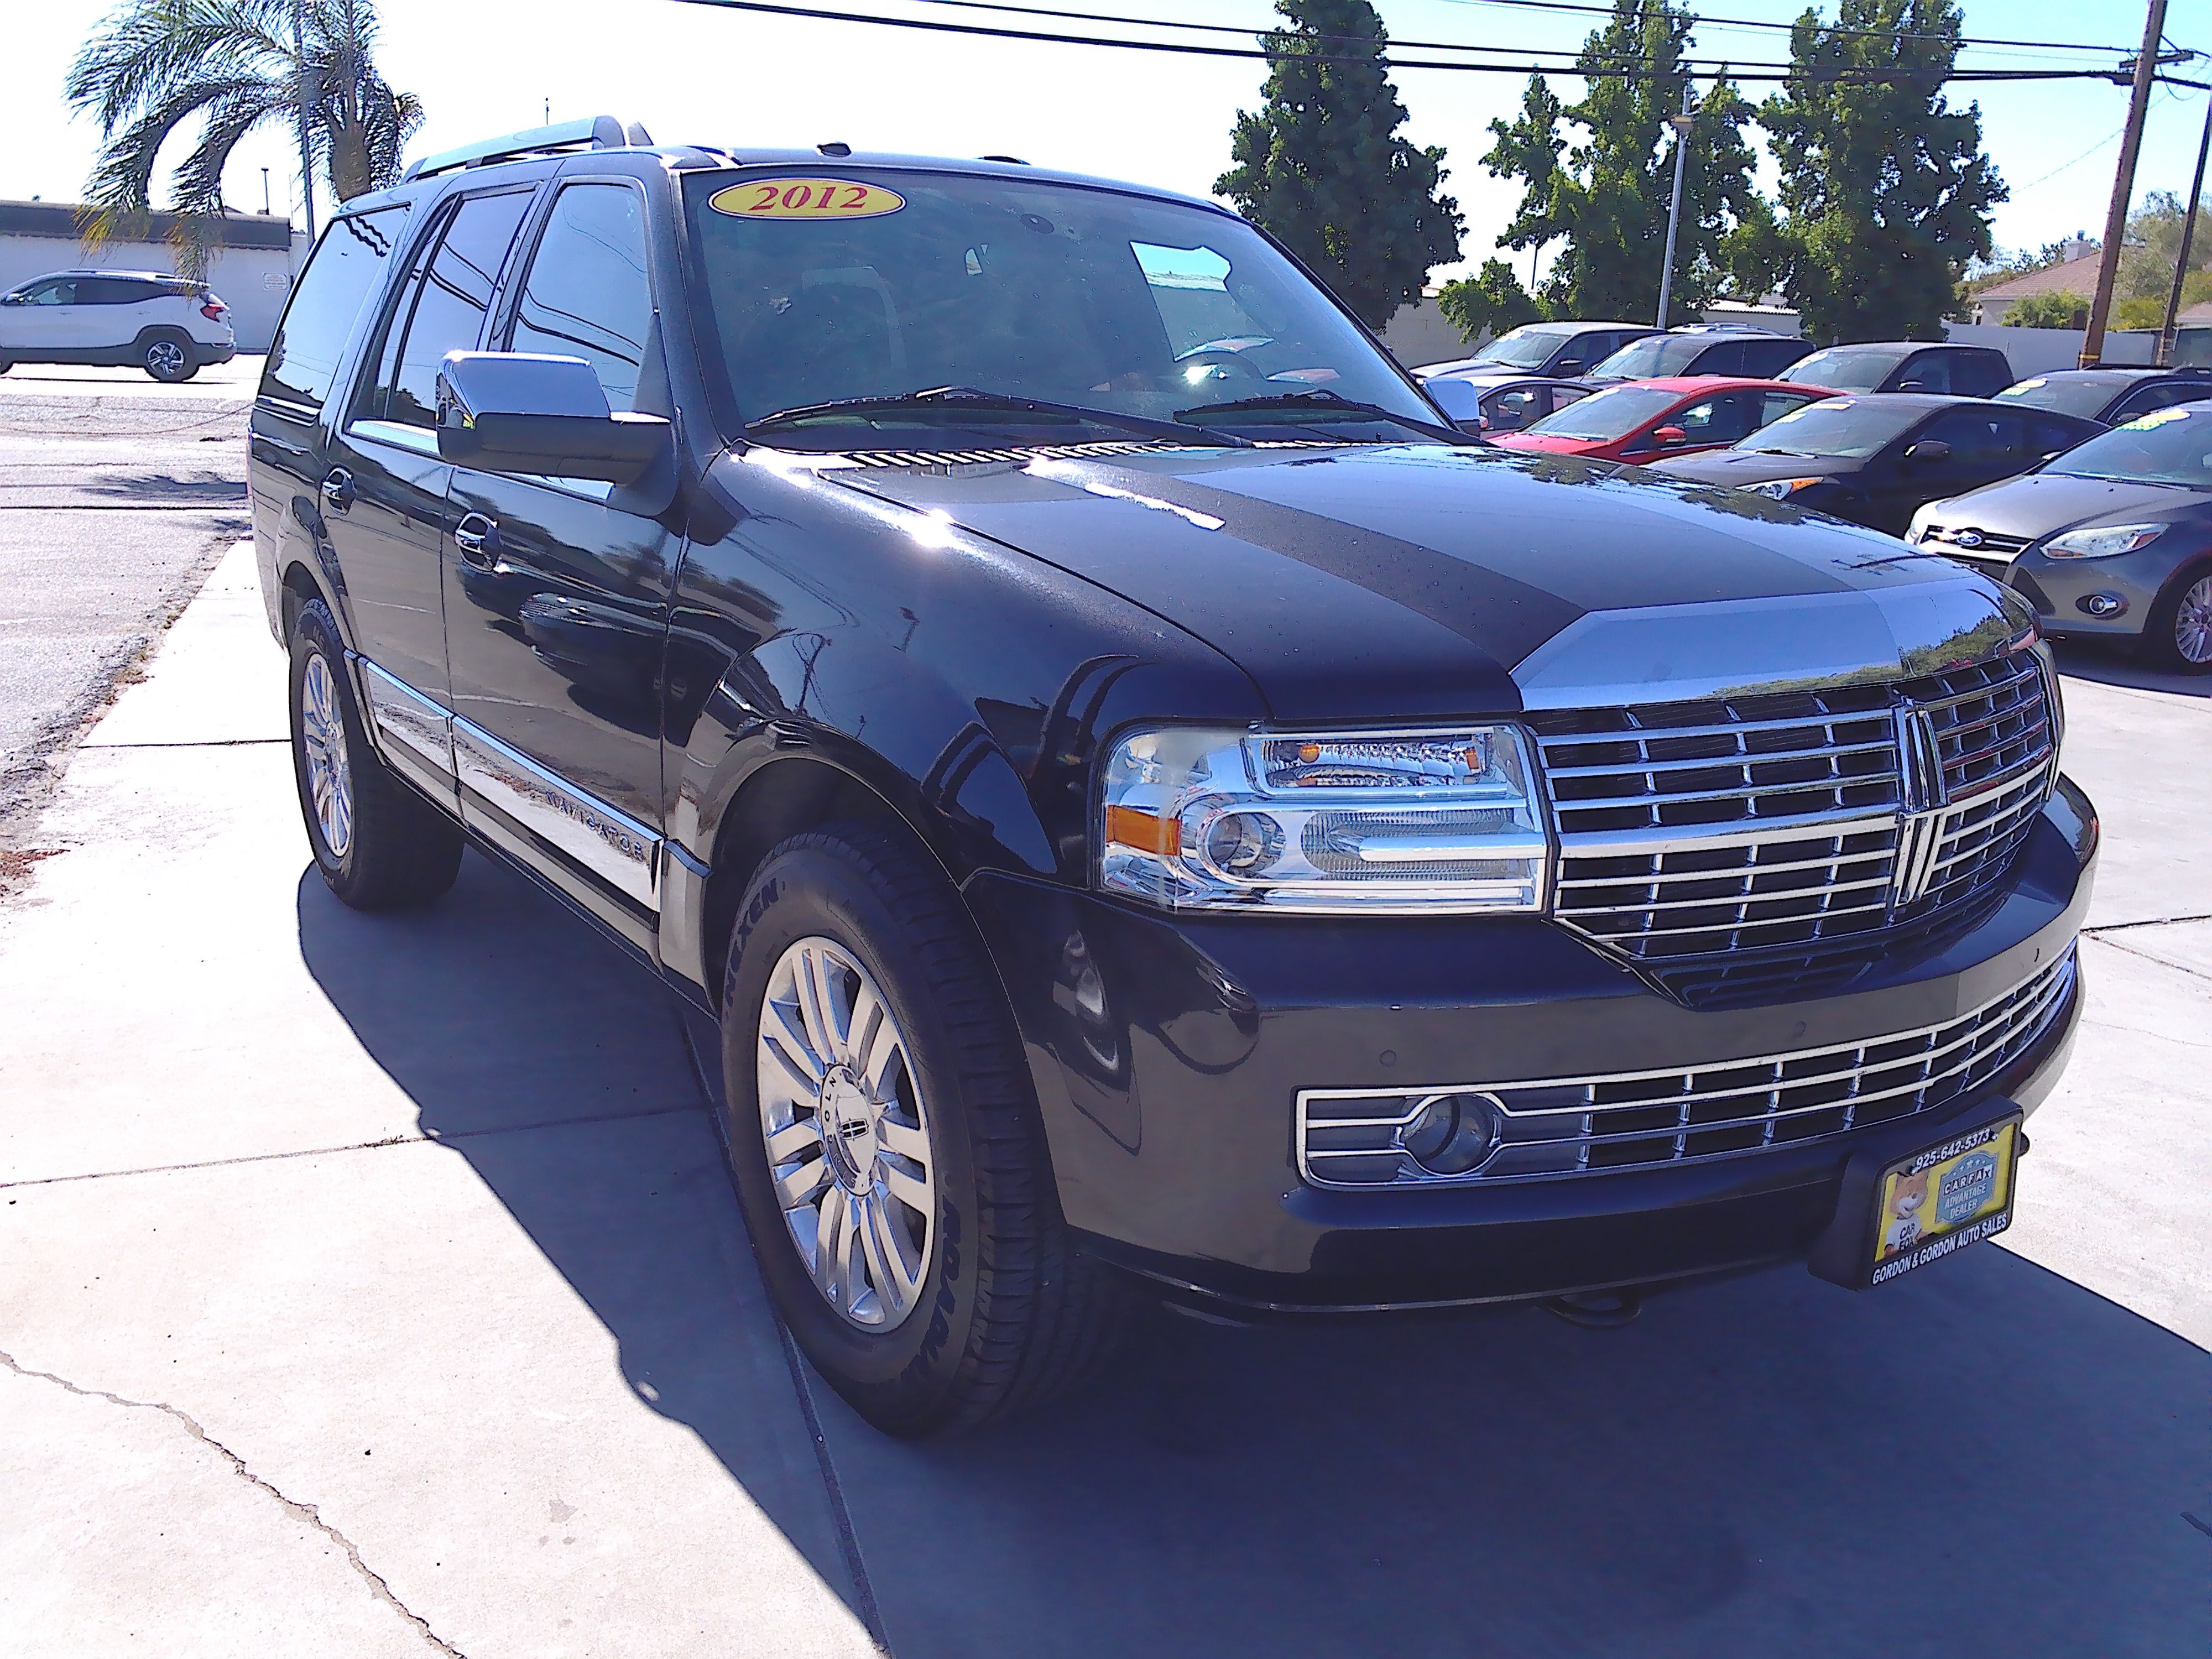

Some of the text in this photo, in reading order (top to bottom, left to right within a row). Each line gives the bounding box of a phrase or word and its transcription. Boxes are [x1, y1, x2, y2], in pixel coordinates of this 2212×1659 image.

[748, 185, 868, 211] 2012
[724, 877, 779, 1008] NEXEN
[1916, 1128, 1991, 1171] 925-642-5373
[1944, 1166, 1991, 1195] CARFAX
[1944, 1182, 1987, 1210] ADVANTAGE
[1950, 1198, 1978, 1219] DEALER
[1900, 1223, 1915, 1240] CAR
[1872, 1213, 2007, 1285] GORDON & GORDON AUTO SALES
